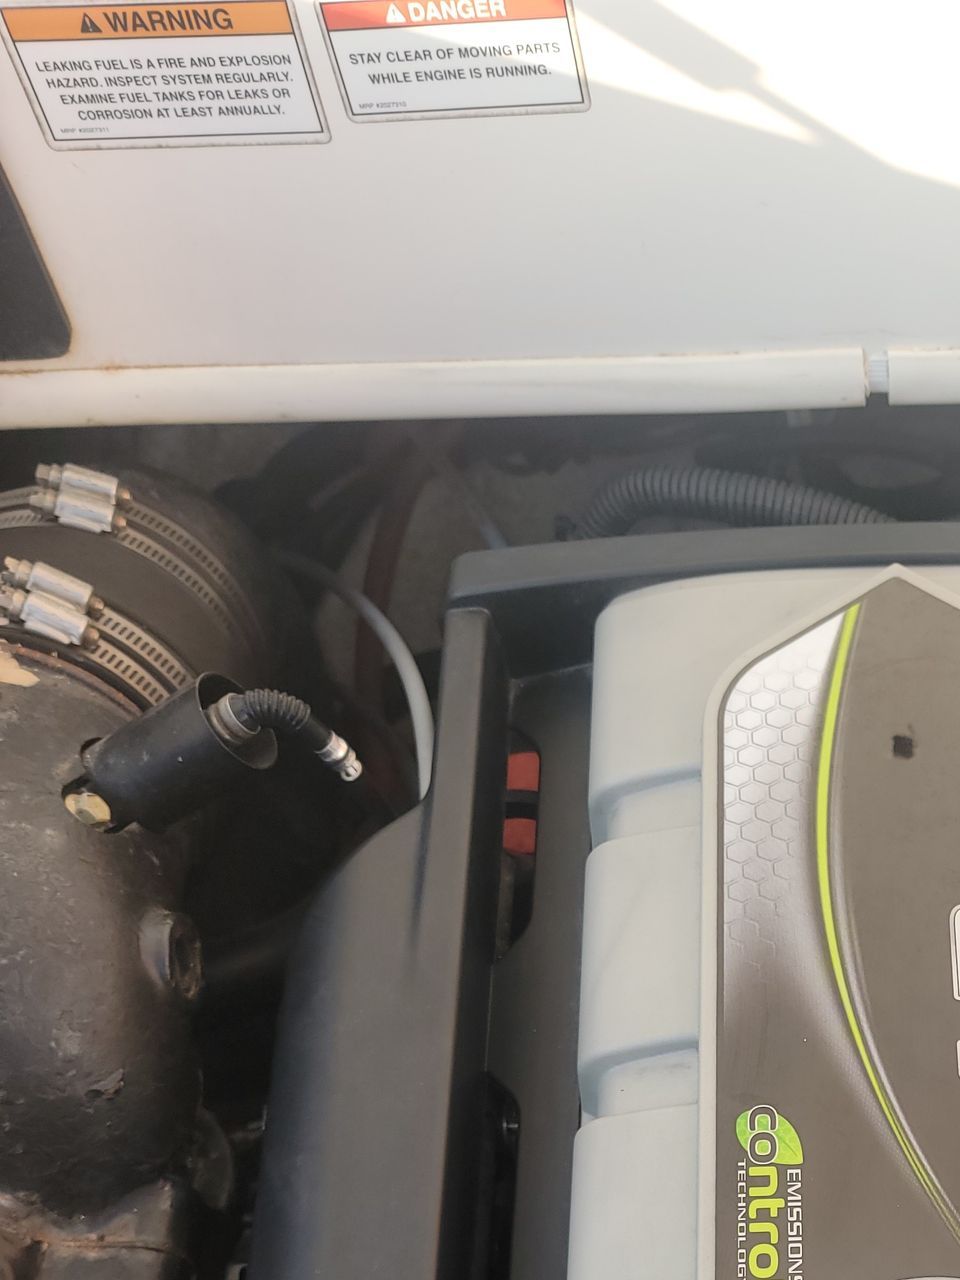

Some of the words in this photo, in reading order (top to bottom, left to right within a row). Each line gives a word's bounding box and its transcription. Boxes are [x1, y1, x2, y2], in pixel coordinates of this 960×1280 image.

[103, 8, 233, 32] WARNING
[407, 0, 506, 22] DANGER
[349, 53, 381, 65] STAY
[386, 50, 433, 63] CLEAR
[436, 49, 454, 60] OF
[459, 45, 513, 58] MOVING
[516, 42, 561, 55] PARTS
[35, 60, 93, 73] LEAKING
[95, 59, 128, 71] FUEL
[130, 58, 143, 70] IS
[147, 58, 156, 69] A
[158, 57, 187, 69] FIRE
[190, 56, 216, 68] AND
[219, 54, 292, 67] EXPLOSION
[46, 76, 103, 89] HAZARD.
[104, 75, 158, 88] INSPECT
[161, 73, 213, 86] SYSTEM
[215, 71, 294, 84] REGULARLY.
[368, 71, 412, 85] WHILE
[415, 69, 466, 82] ENGINE
[470, 68, 482, 79] IS
[486, 65, 552, 79] RUNNING.
[60, 92, 117, 106] EXAMINE
[120, 91, 152, 104] FUEL
[153, 90, 197, 103] TANKS
[199, 89, 225, 101] FOR
[227, 88, 270, 100] LEAKS
[272, 87, 291, 99] OR
[78, 108, 154, 121] CORROSION
[156, 107, 171, 118] AT
[174, 106, 214, 118] LEAST
[217, 104, 286, 117] ANNUALLY.
